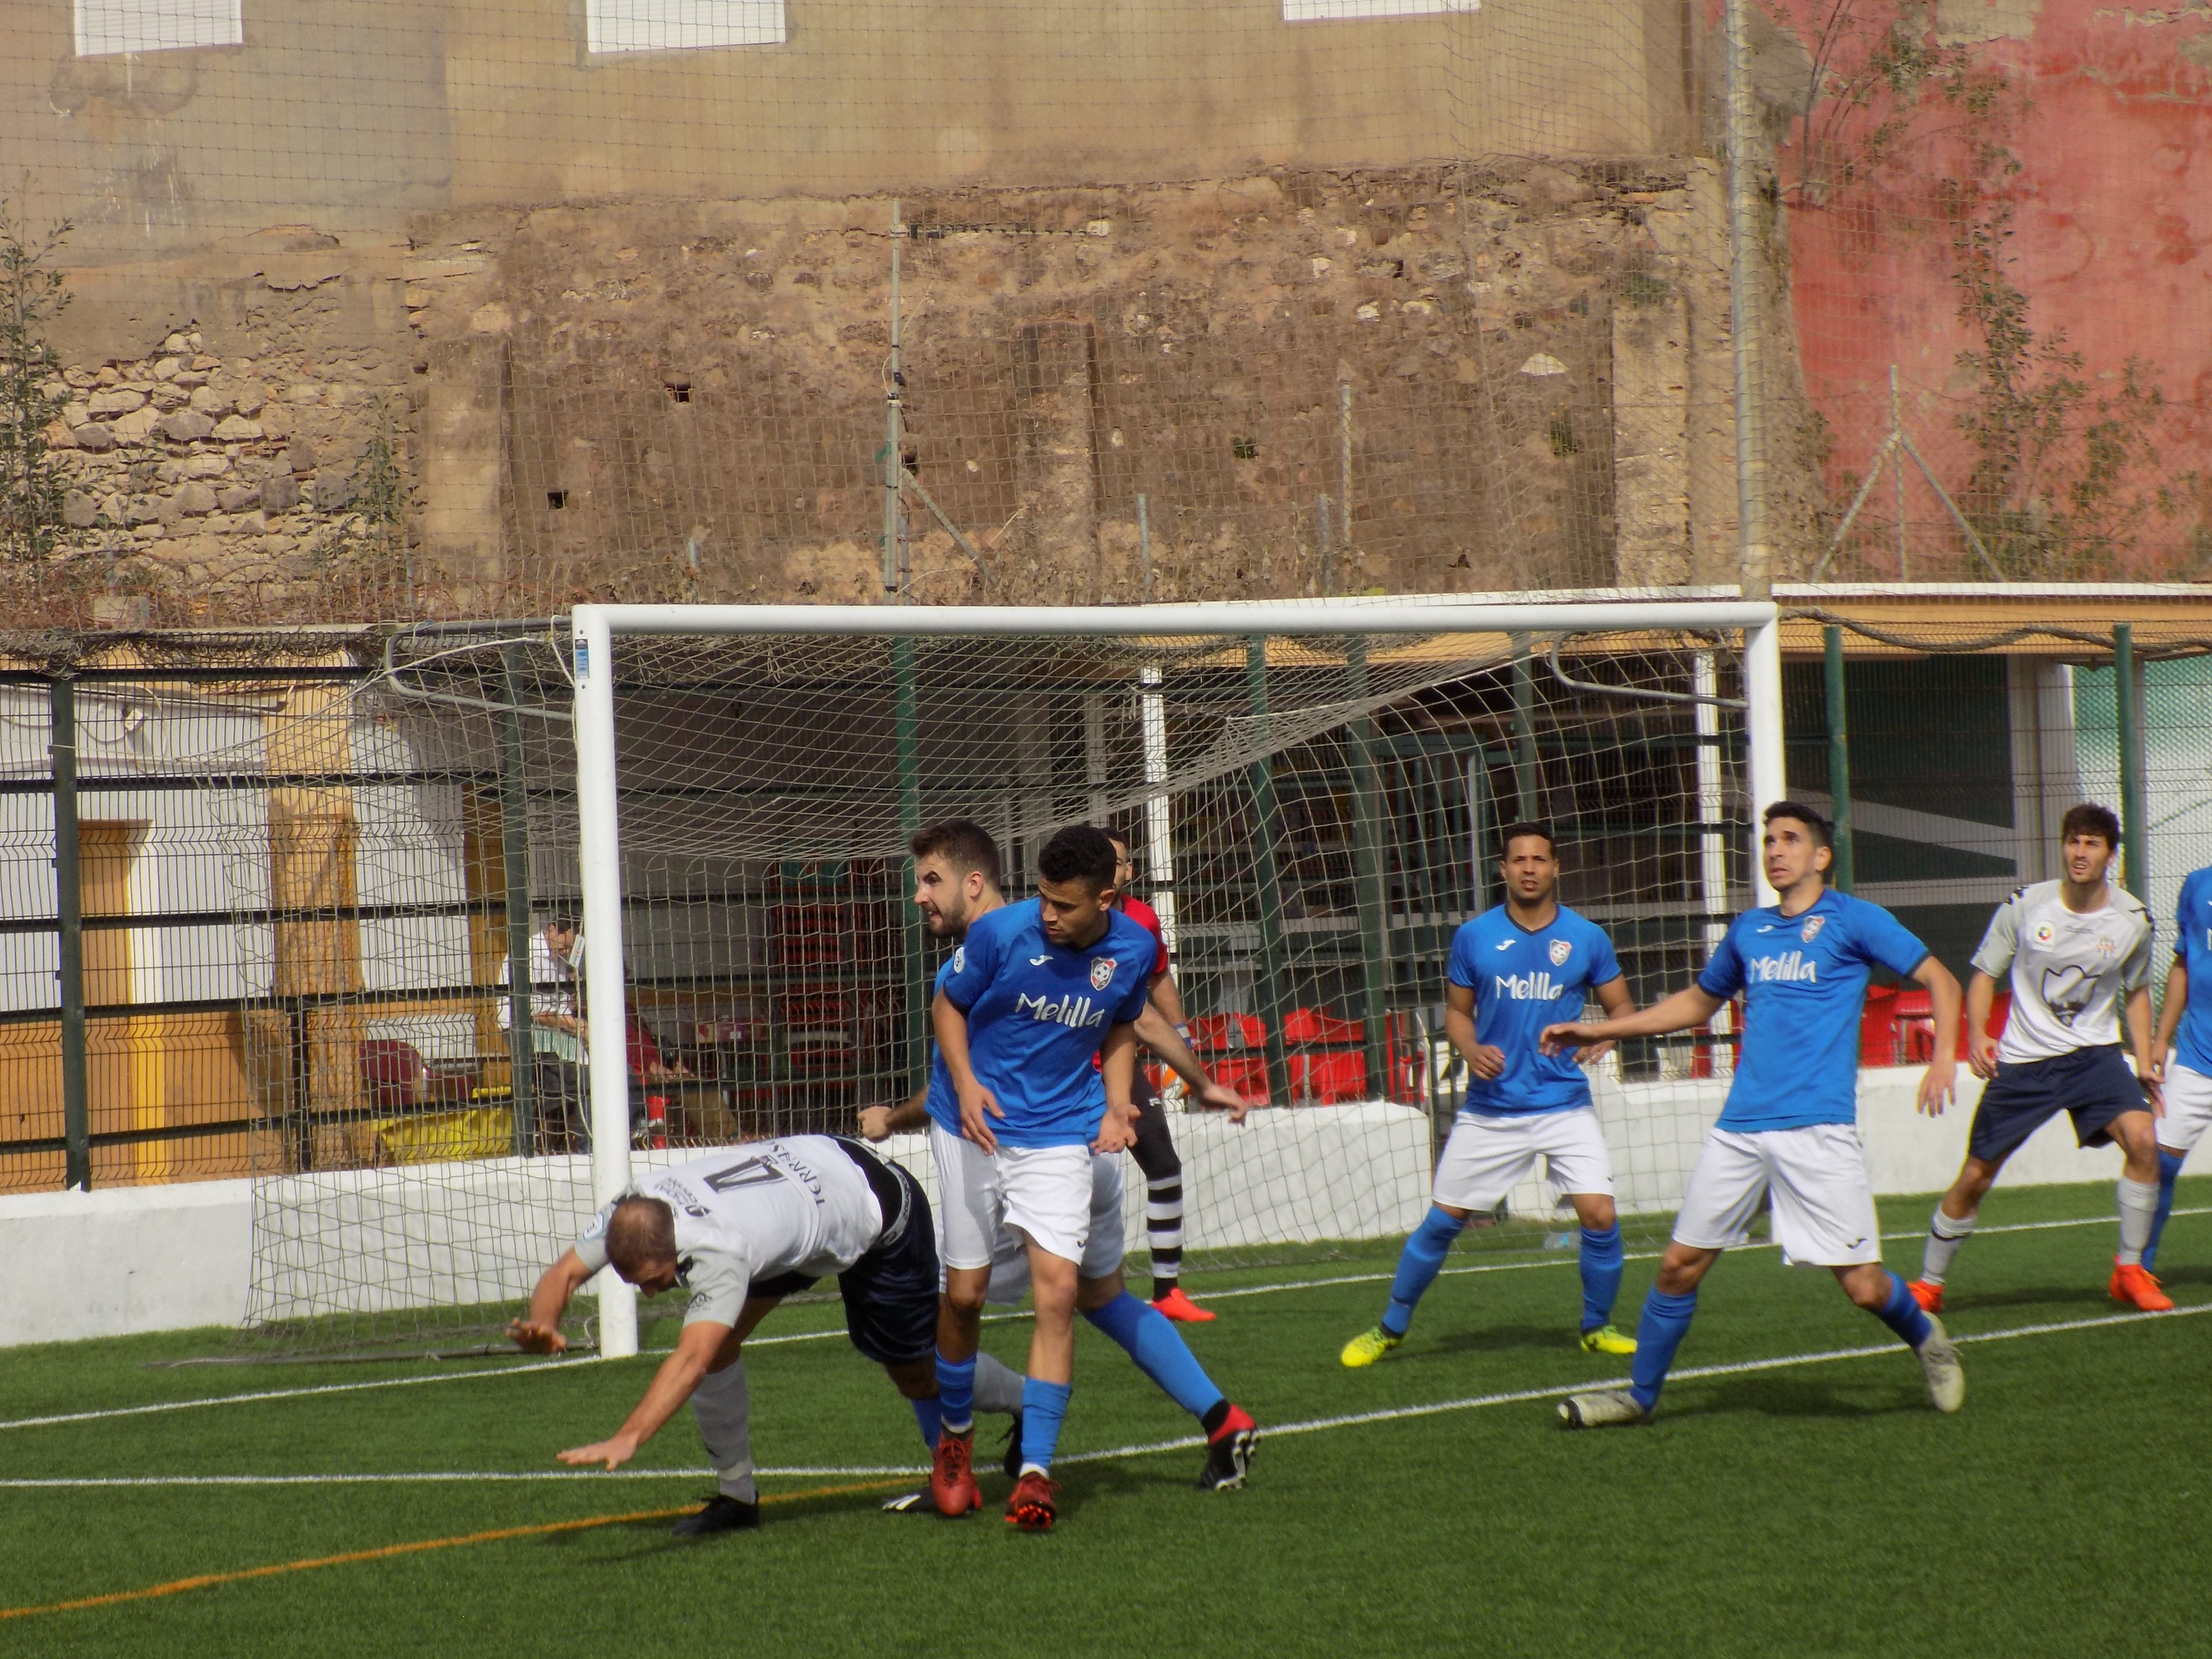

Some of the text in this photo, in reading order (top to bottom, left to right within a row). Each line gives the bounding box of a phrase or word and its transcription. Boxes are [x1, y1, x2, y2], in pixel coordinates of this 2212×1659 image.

[1749, 950, 1817, 984] Melilla
[1496, 971, 1564, 1001] Melilla
[1015, 992, 1106, 1028] Melilla
